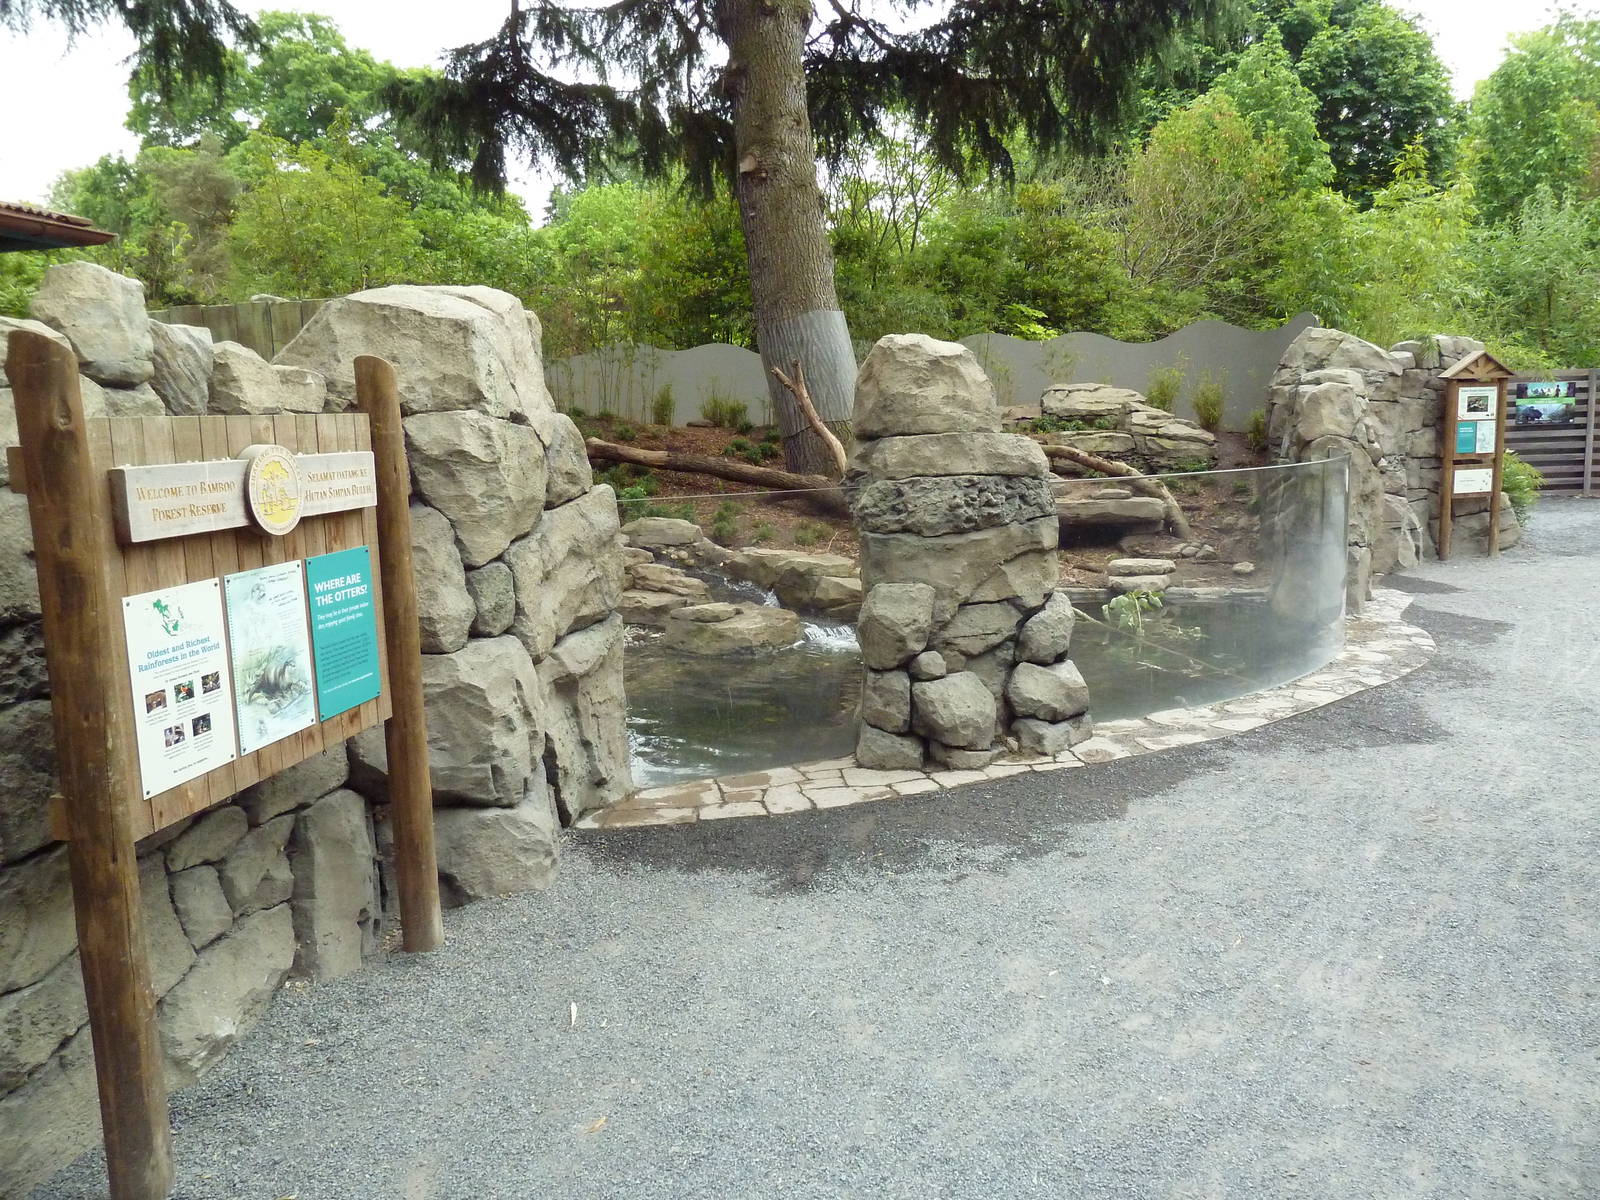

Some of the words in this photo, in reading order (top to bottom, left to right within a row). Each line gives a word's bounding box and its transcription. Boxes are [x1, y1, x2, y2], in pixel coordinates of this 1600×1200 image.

[136, 486, 184, 501] WELCOME
[186, 485, 197, 497] TO
[199, 481, 236, 495] BAMBOO
[305, 489, 328, 502] HUTAN
[152, 507, 187, 521] FOREST
[188, 503, 228, 517] RESERVE
[314, 576, 345, 593] WHERE
[346, 572, 362, 586] ARE
[315, 593, 334, 607] THE
[334, 584, 368, 601] OTTERS?
[138, 655, 180, 672] Rainforests
[180, 652, 188, 660] in
[188, 650, 200, 658] the
[200, 641, 220, 654] World
[147, 647, 170, 660] Oldest
[172, 643, 184, 653] and
[186, 636, 210, 648] Richest
